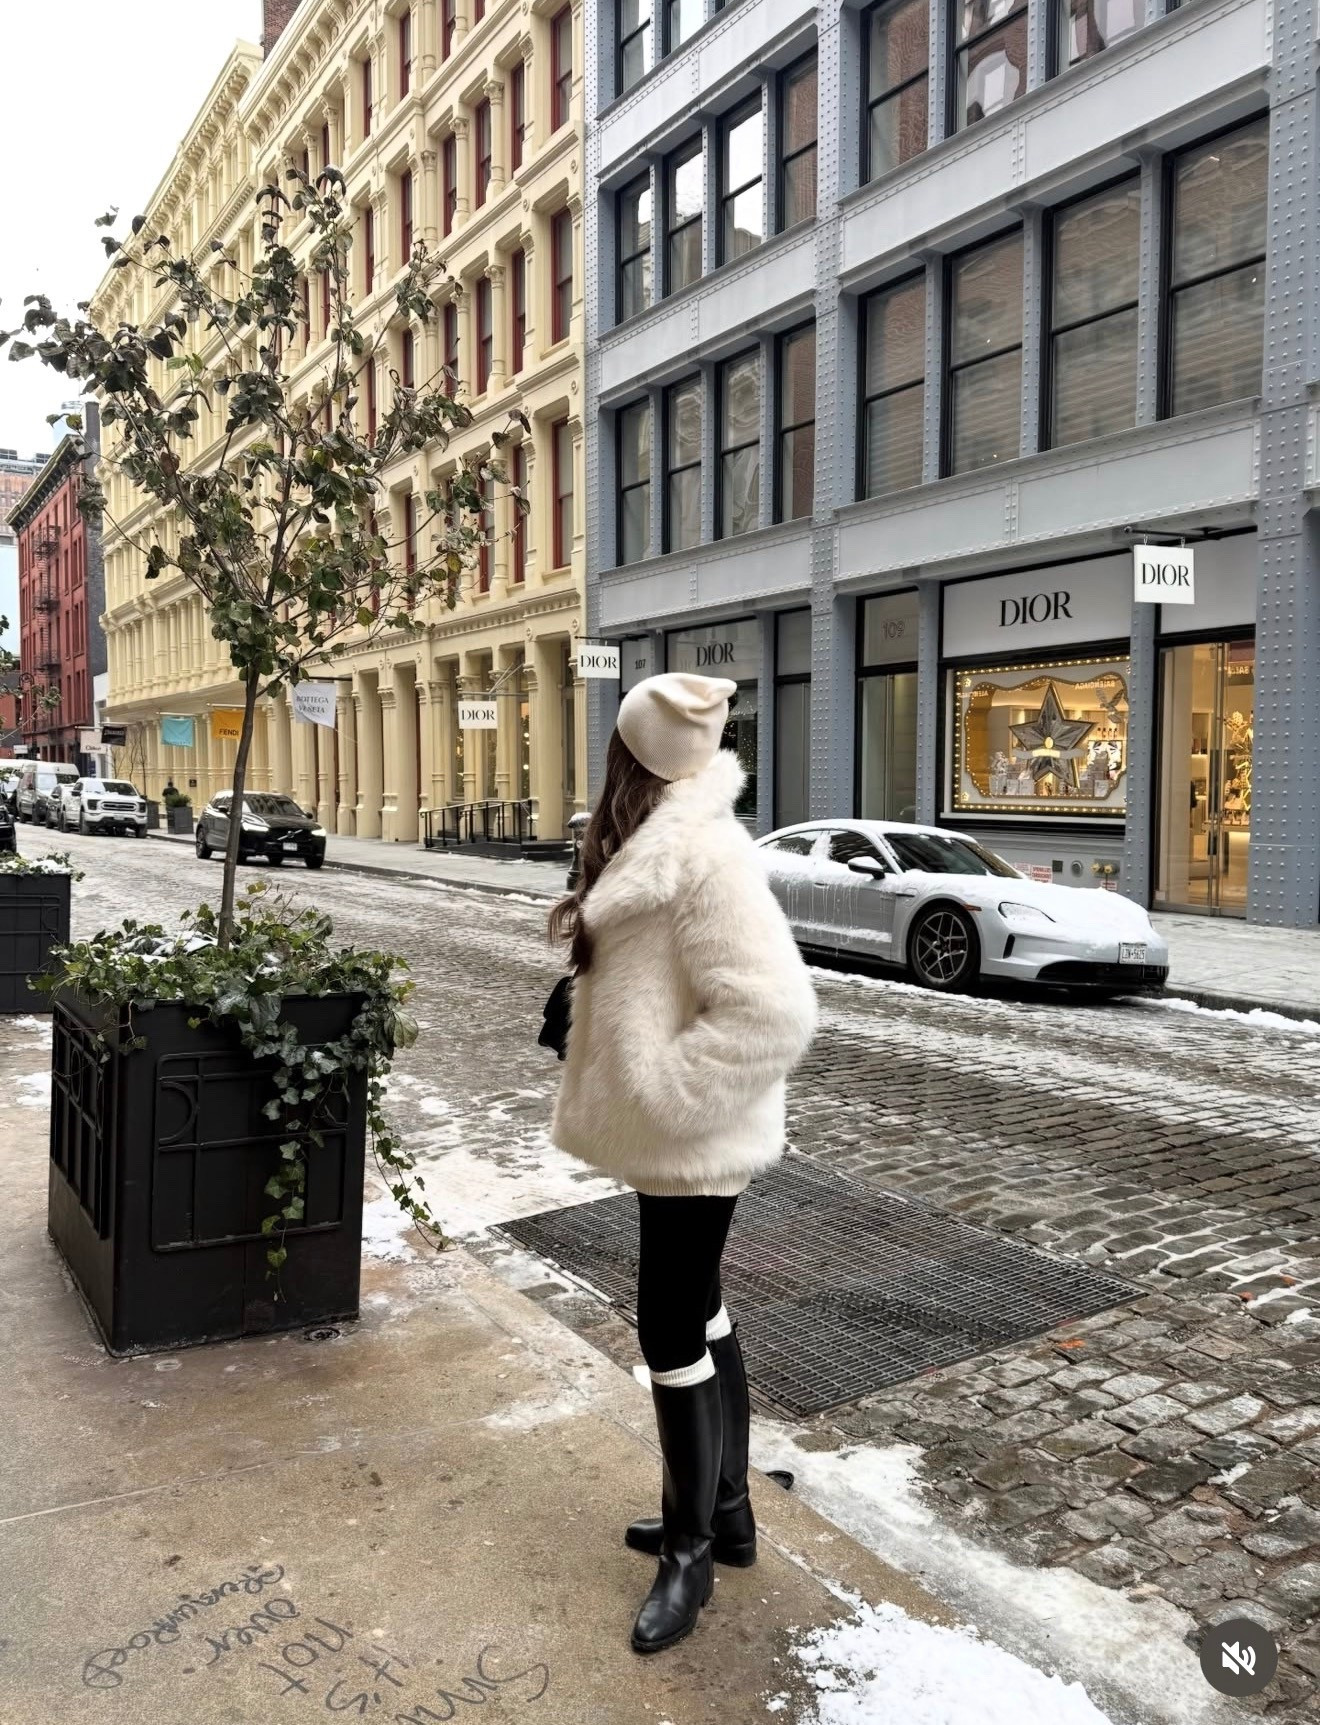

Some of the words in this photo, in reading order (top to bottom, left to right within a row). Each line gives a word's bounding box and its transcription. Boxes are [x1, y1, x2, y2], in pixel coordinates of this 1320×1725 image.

[1141, 562, 1190, 587] DIOR
[998, 591, 1073, 628] DIOR
[881, 620, 905, 640] 109
[580, 655, 617, 669] DIOR
[696, 642, 736, 668] DIOR
[634, 658, 646, 670] 107
[296, 695, 329, 704] BOTTEGA
[461, 708, 495, 721] DIOR
[219, 728, 239, 736] FENDI
